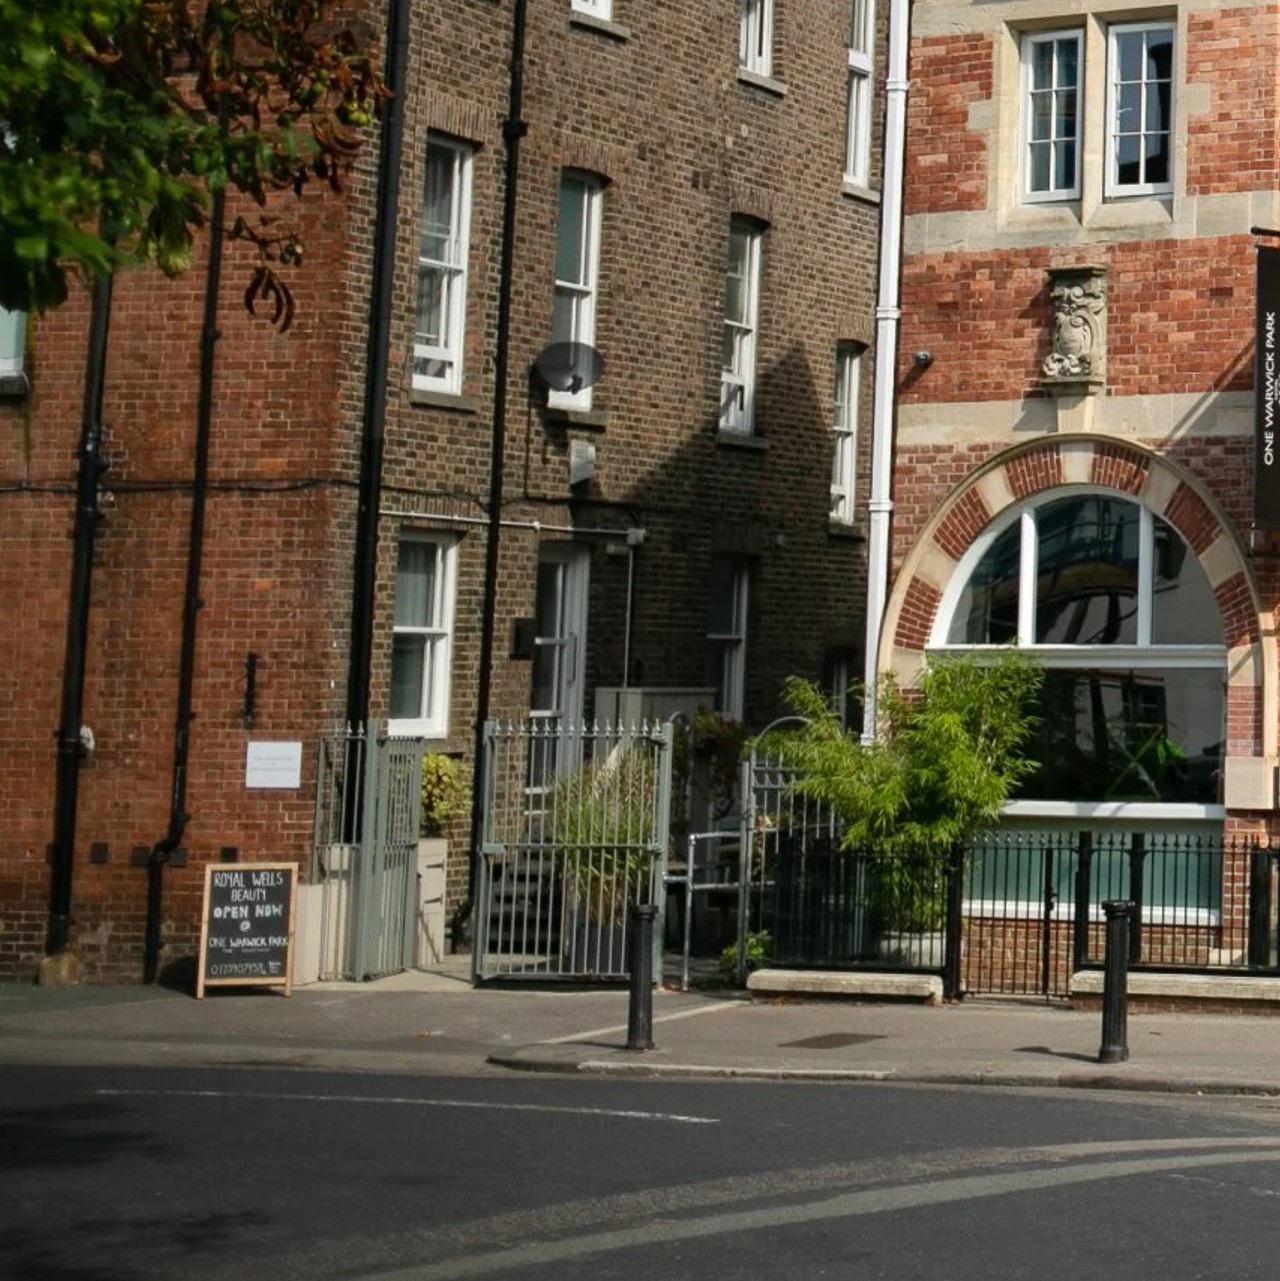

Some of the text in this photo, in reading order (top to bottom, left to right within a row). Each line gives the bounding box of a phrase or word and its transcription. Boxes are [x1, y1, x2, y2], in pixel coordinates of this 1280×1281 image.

[1264, 311, 1276, 466] ONE WARWICK PARK
[214, 872, 284, 888] ROYAL WELLS
[231, 889, 266, 901] BEAUTY
[213, 905, 283, 919] OPEN NOW
[209, 936, 288, 947] ONE WARWICK PARK
